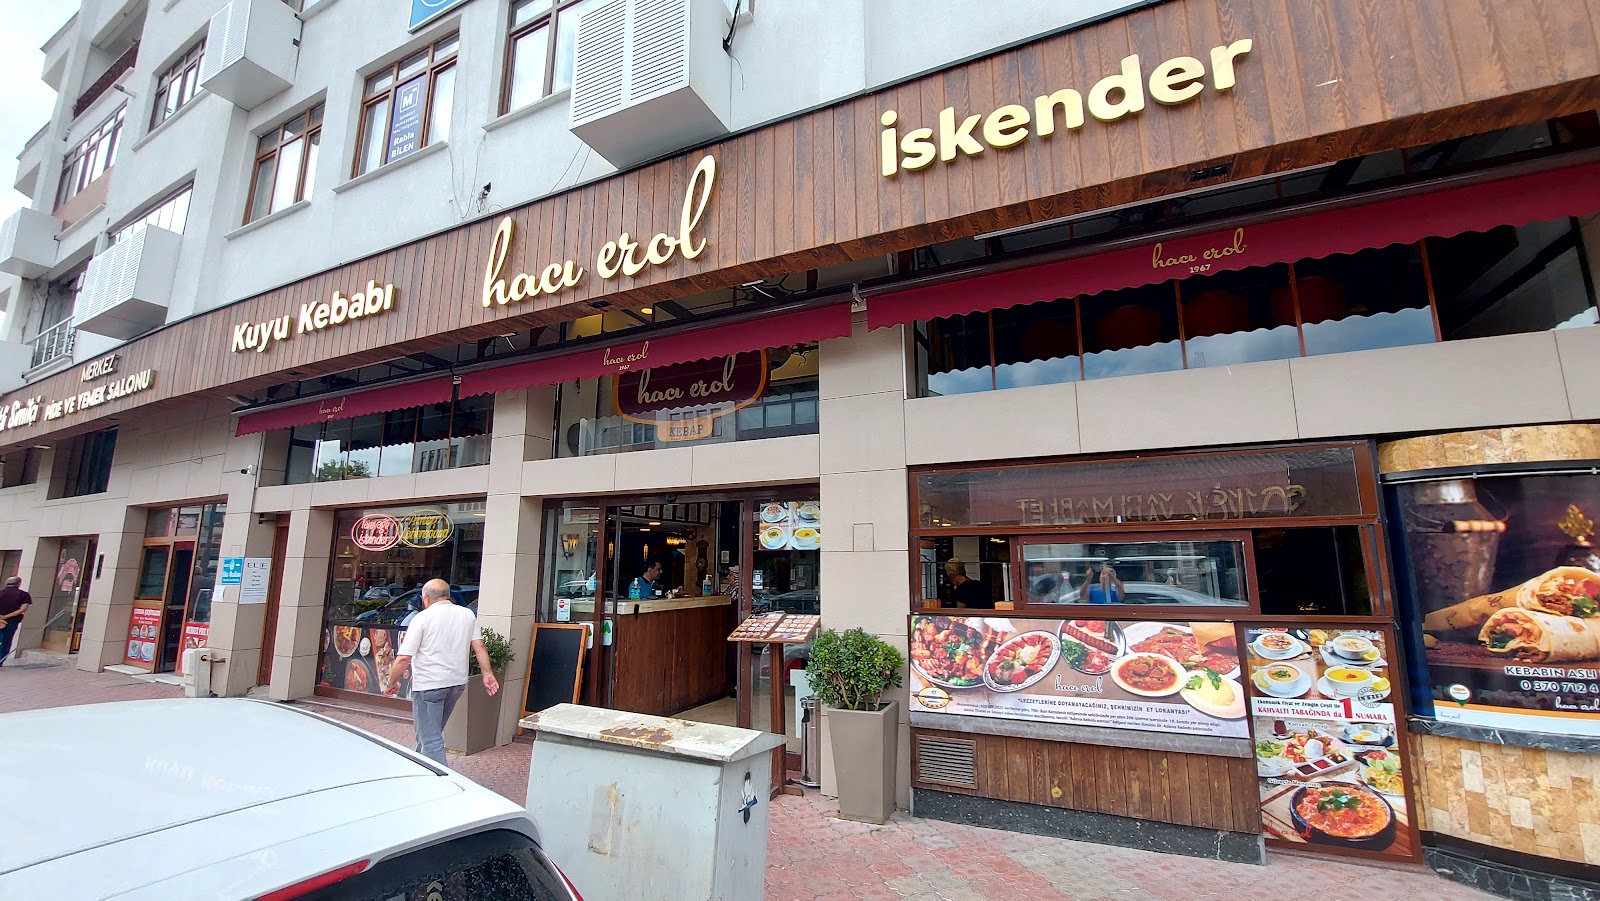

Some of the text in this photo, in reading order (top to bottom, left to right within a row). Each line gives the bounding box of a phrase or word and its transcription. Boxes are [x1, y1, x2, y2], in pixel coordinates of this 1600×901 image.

[879, 38, 1254, 178] iskender
[391, 142, 415, 158] BİLEN
[393, 132, 415, 146] Rabia
[482, 155, 716, 308] hacı erol
[1153, 228, 1245, 268] hacı erol
[1190, 264, 1211, 273] 1967
[231, 280, 395, 352] Kuyu Kebabı
[603, 341, 649, 366] hacı erol
[81, 354, 117, 383] MERKEZ
[638, 354, 736, 404] hacı erol
[64, 396, 77, 414] VE
[77, 385, 107, 410] YEMEK
[107, 369, 151, 400] SALONU
[668, 425, 704, 437] KEBAP
[1055, 674, 1104, 693] hacı erol
[1504, 665, 1597, 679] KEBABIN ASLI
[1521, 680, 1531, 690] 0
[1533, 681, 1559, 692] 370
[1561, 682, 1587, 693] 712
[1339, 697, 1353, 719] 1
[1355, 712, 1388, 721] NUMARA
